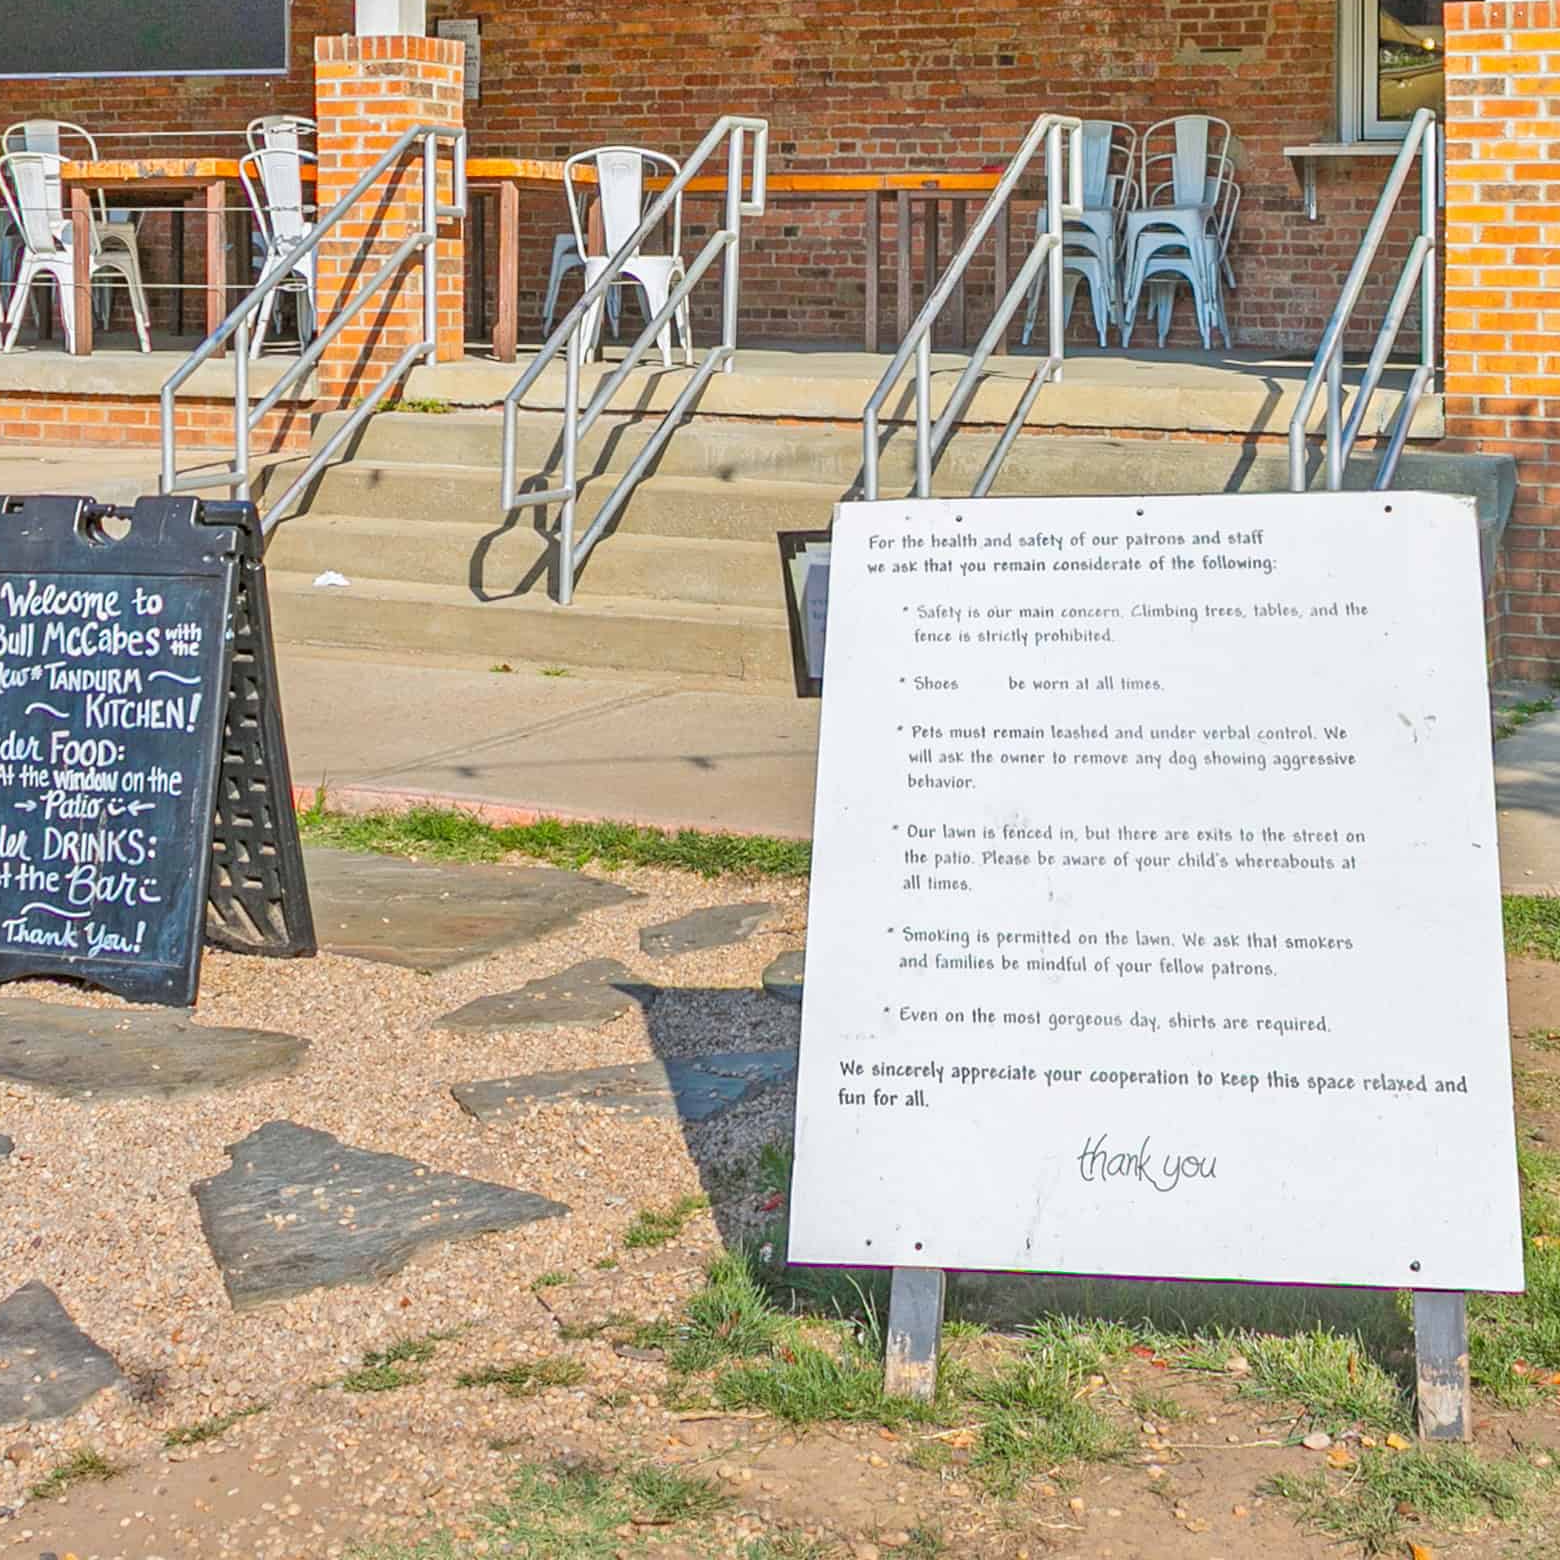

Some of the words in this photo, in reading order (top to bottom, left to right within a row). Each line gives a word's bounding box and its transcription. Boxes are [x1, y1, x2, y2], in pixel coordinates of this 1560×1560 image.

[868, 534, 896, 551] For
[901, 533, 925, 550] the
[930, 532, 978, 549] health
[983, 532, 1013, 548] and
[1018, 531, 1064, 552] safety
[1069, 530, 1087, 548] of
[1091, 535, 1120, 547] our
[1125, 532, 1186, 551] patrons
[1191, 529, 1222, 546] and
[1227, 528, 1265, 545] staff
[866, 562, 886, 575] we
[891, 560, 918, 574] ask
[923, 557, 953, 574] that
[959, 561, 987, 577] you
[992, 558, 1047, 573] remain
[1051, 555, 1143, 572] considerate
[1148, 554, 1166, 572] of
[1171, 554, 1197, 571] the
[1201, 554, 1278, 576] following:
[1, 580, 122, 620] Welcome
[131, 587, 163, 615] to
[916, 603, 962, 624] Safety
[967, 607, 981, 619] is
[986, 607, 1013, 619] our
[1018, 607, 1055, 619] main
[1060, 607, 1124, 619] concern.
[1130, 602, 1199, 624] Climbing
[1204, 604, 1247, 619] trees,
[1253, 602, 1303, 620] tables,
[1309, 601, 1339, 617] and
[1344, 601, 1369, 617] the
[42, 621, 160, 656] McCabes
[166, 623, 202, 641] with
[913, 627, 953, 644] fence
[958, 631, 971, 643] is
[977, 627, 1029, 648] strictly
[1034, 627, 1116, 648] prohibited.
[170, 640, 200, 656] the
[44, 661, 142, 694] TANDURM
[913, 675, 960, 691] Shoes
[1008, 674, 1026, 691] be
[1032, 679, 1070, 691] worn
[1075, 676, 1090, 691] at
[1095, 674, 1115, 691] all
[1120, 677, 1165, 691] times.
[86, 693, 202, 733] KITCHEN!
[911, 724, 944, 740] Pets
[948, 725, 987, 740] must
[992, 725, 1045, 740] remain
[1050, 723, 1109, 740] leashed
[1114, 724, 1144, 740] and
[1149, 724, 1197, 740] under
[1202, 724, 1251, 741] verbal
[1256, 724, 1317, 741] control.
[1322, 725, 1349, 741] We
[50, 730, 125, 766] FOOD:
[18, 766, 50, 787] the
[53, 768, 120, 792] window
[122, 772, 144, 793] on
[146, 766, 183, 794] the
[907, 772, 976, 790] behavior.
[40, 790, 104, 819] Patio
[43, 828, 157, 865] DRINKS:
[906, 823, 937, 840] Our
[942, 823, 977, 839] lawn
[982, 826, 997, 840] is
[1002, 823, 1053, 841] fenced
[1059, 828, 1079, 842] in,
[1084, 824, 1111, 841] but
[1117, 824, 1158, 841] there
[1163, 829, 1190, 841] are
[1196, 827, 1233, 842] exits
[1239, 827, 1255, 843] to
[1261, 826, 1287, 843] the
[1292, 828, 1339, 844] street
[1345, 831, 1366, 844] on
[14, 864, 59, 892] the
[65, 865, 137, 906] Bar
[902, 873, 921, 891] all
[927, 875, 973, 892] times.
[2, 918, 79, 947] Thank
[84, 921, 146, 957] You!
[901, 925, 971, 949] Smoking
[976, 928, 991, 944] is
[995, 928, 1072, 949] permitted
[1077, 933, 1098, 945] on
[1104, 929, 1129, 946] the
[1135, 929, 1176, 947] lawn.
[1181, 931, 1206, 948] We
[1212, 934, 1241, 948] ask
[1246, 931, 1278, 950] that
[1284, 935, 1354, 950] smokers
[899, 1005, 939, 1023] Even
[944, 1010, 965, 1024] on
[971, 1006, 997, 1025] the
[1002, 1010, 1041, 1025] most
[1047, 1013, 1123, 1033] gorgeous
[1129, 1010, 1161, 1033] day,
[1167, 1011, 1217, 1030] shirts
[1222, 1017, 1249, 1031] are
[1255, 1015, 1332, 1037] required.
[839, 1058, 865, 1077] We
[871, 1059, 945, 1085] sincerely
[950, 1064, 1038, 1086] appreciate
[1043, 1068, 1083, 1088] your
[1089, 1068, 1190, 1090] cooperation
[1196, 1069, 1214, 1087] to
[1219, 1071, 1261, 1094] keep
[1266, 1069, 1301, 1089] this
[1306, 1075, 1356, 1096] space
[1362, 1072, 1428, 1093] relaxed
[1434, 1074, 1469, 1095] and
[837, 1086, 866, 1106] fun
[872, 1087, 899, 1107] for
[904, 1088, 930, 1109] all.
[1076, 1132, 1155, 1185] thank
[1153, 1153, 1218, 1193] you
